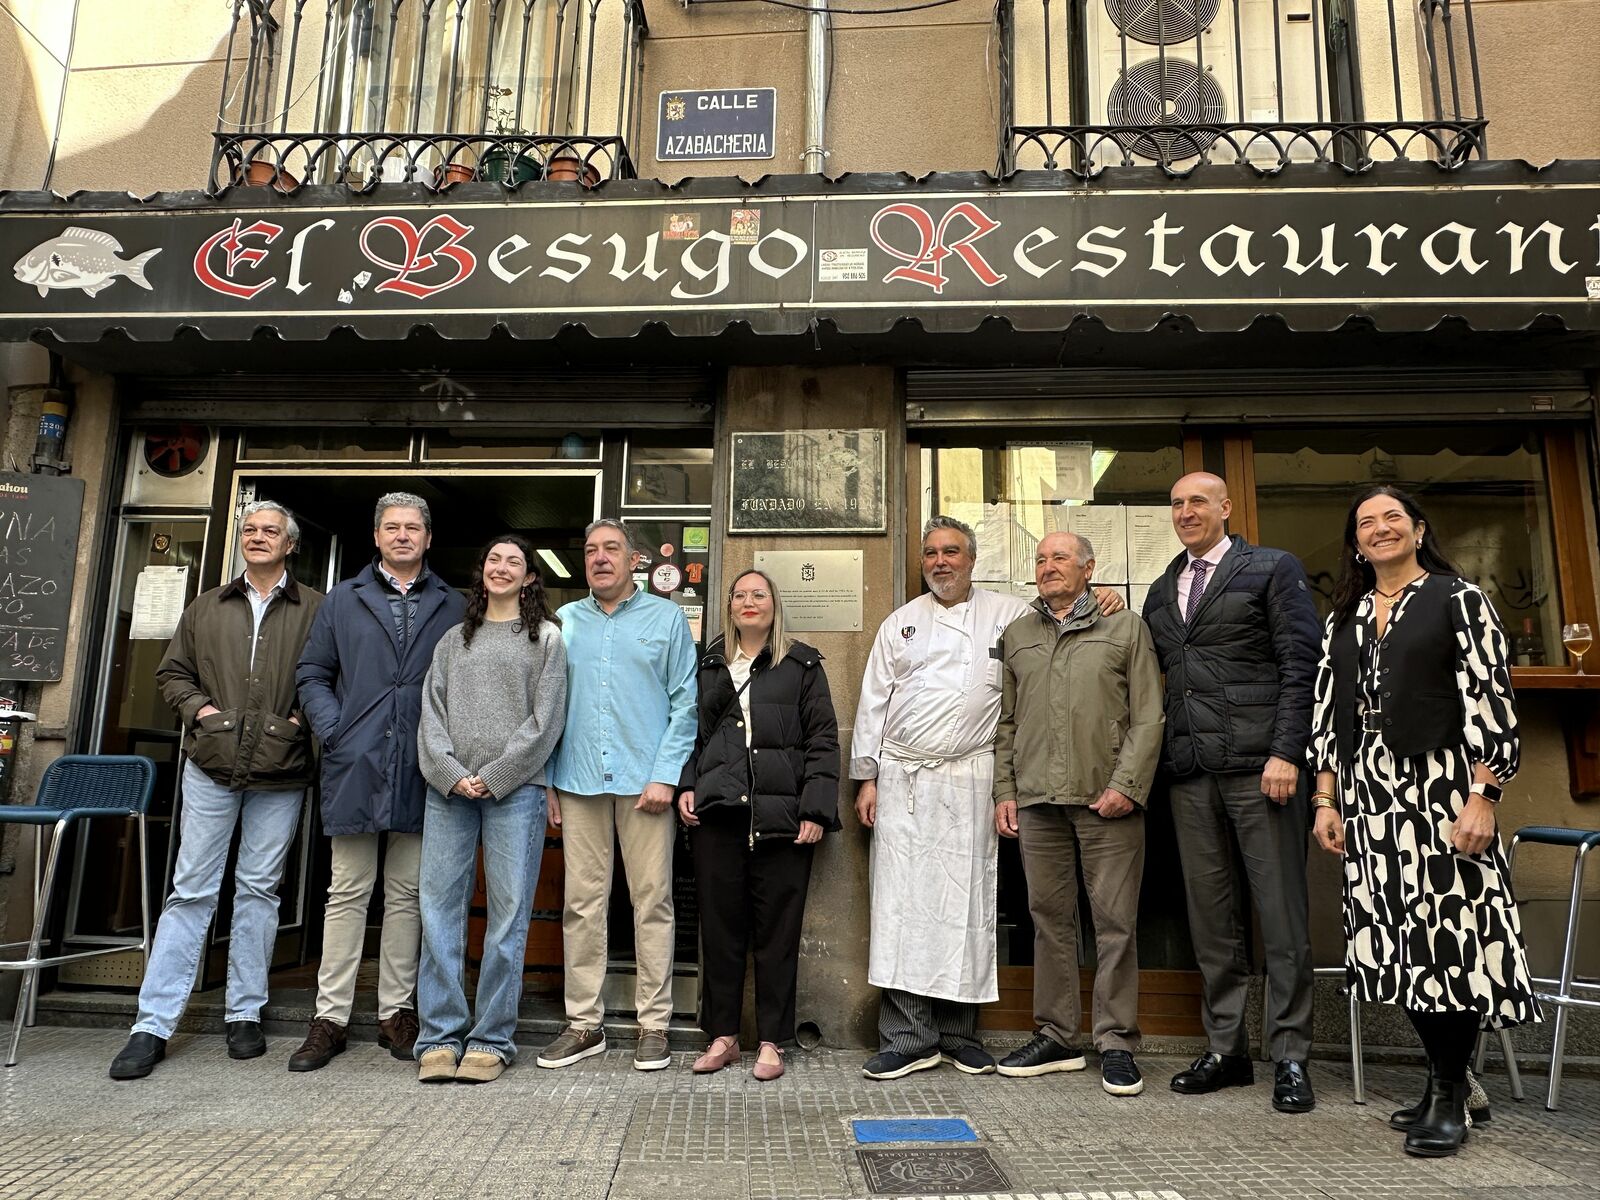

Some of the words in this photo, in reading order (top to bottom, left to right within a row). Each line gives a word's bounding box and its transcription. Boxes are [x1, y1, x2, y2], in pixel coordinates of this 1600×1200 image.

[697, 94, 759, 111] CALLE
[665, 133, 767, 155] AZABACHERIA
[193, 217, 336, 300] El
[358, 213, 808, 300] Besugo
[740, 498, 805, 511] FUNDADO
[0, 511, 55, 542] NA
